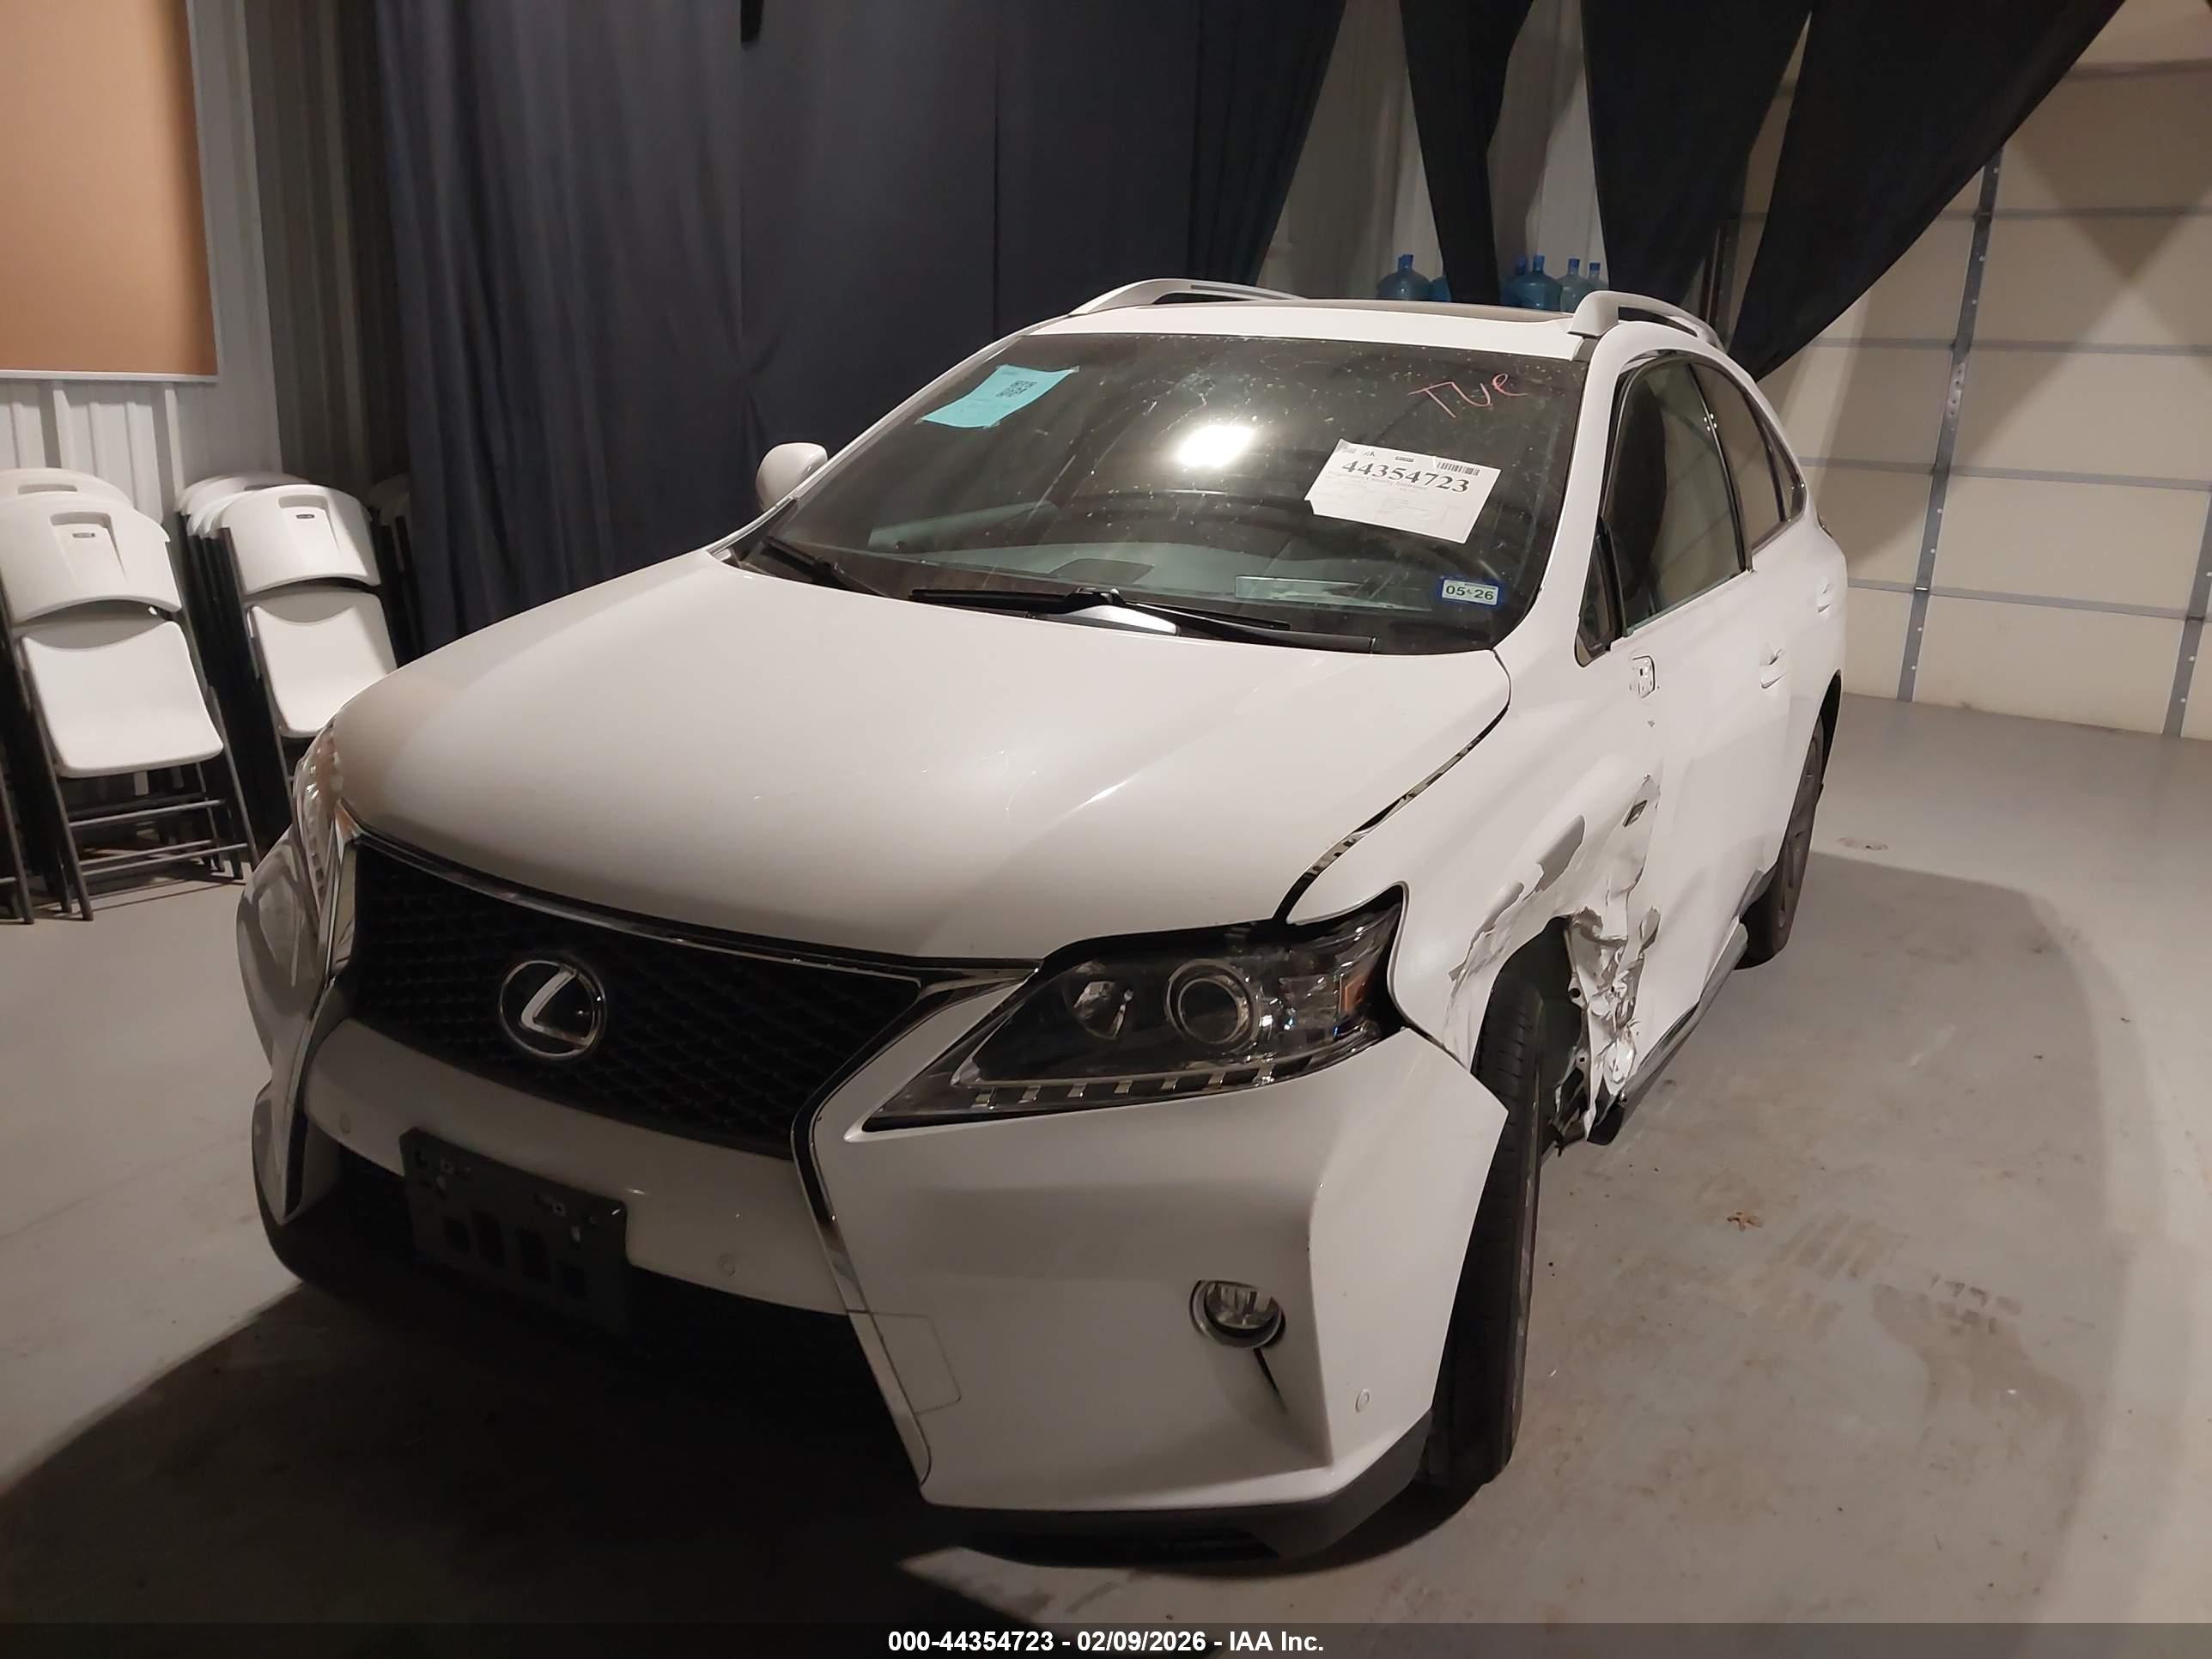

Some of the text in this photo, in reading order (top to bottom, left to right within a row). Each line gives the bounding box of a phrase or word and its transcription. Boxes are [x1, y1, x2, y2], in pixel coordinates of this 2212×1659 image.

[1341, 459, 1471, 493] 44354723
[1445, 585, 1495, 601] 05 26
